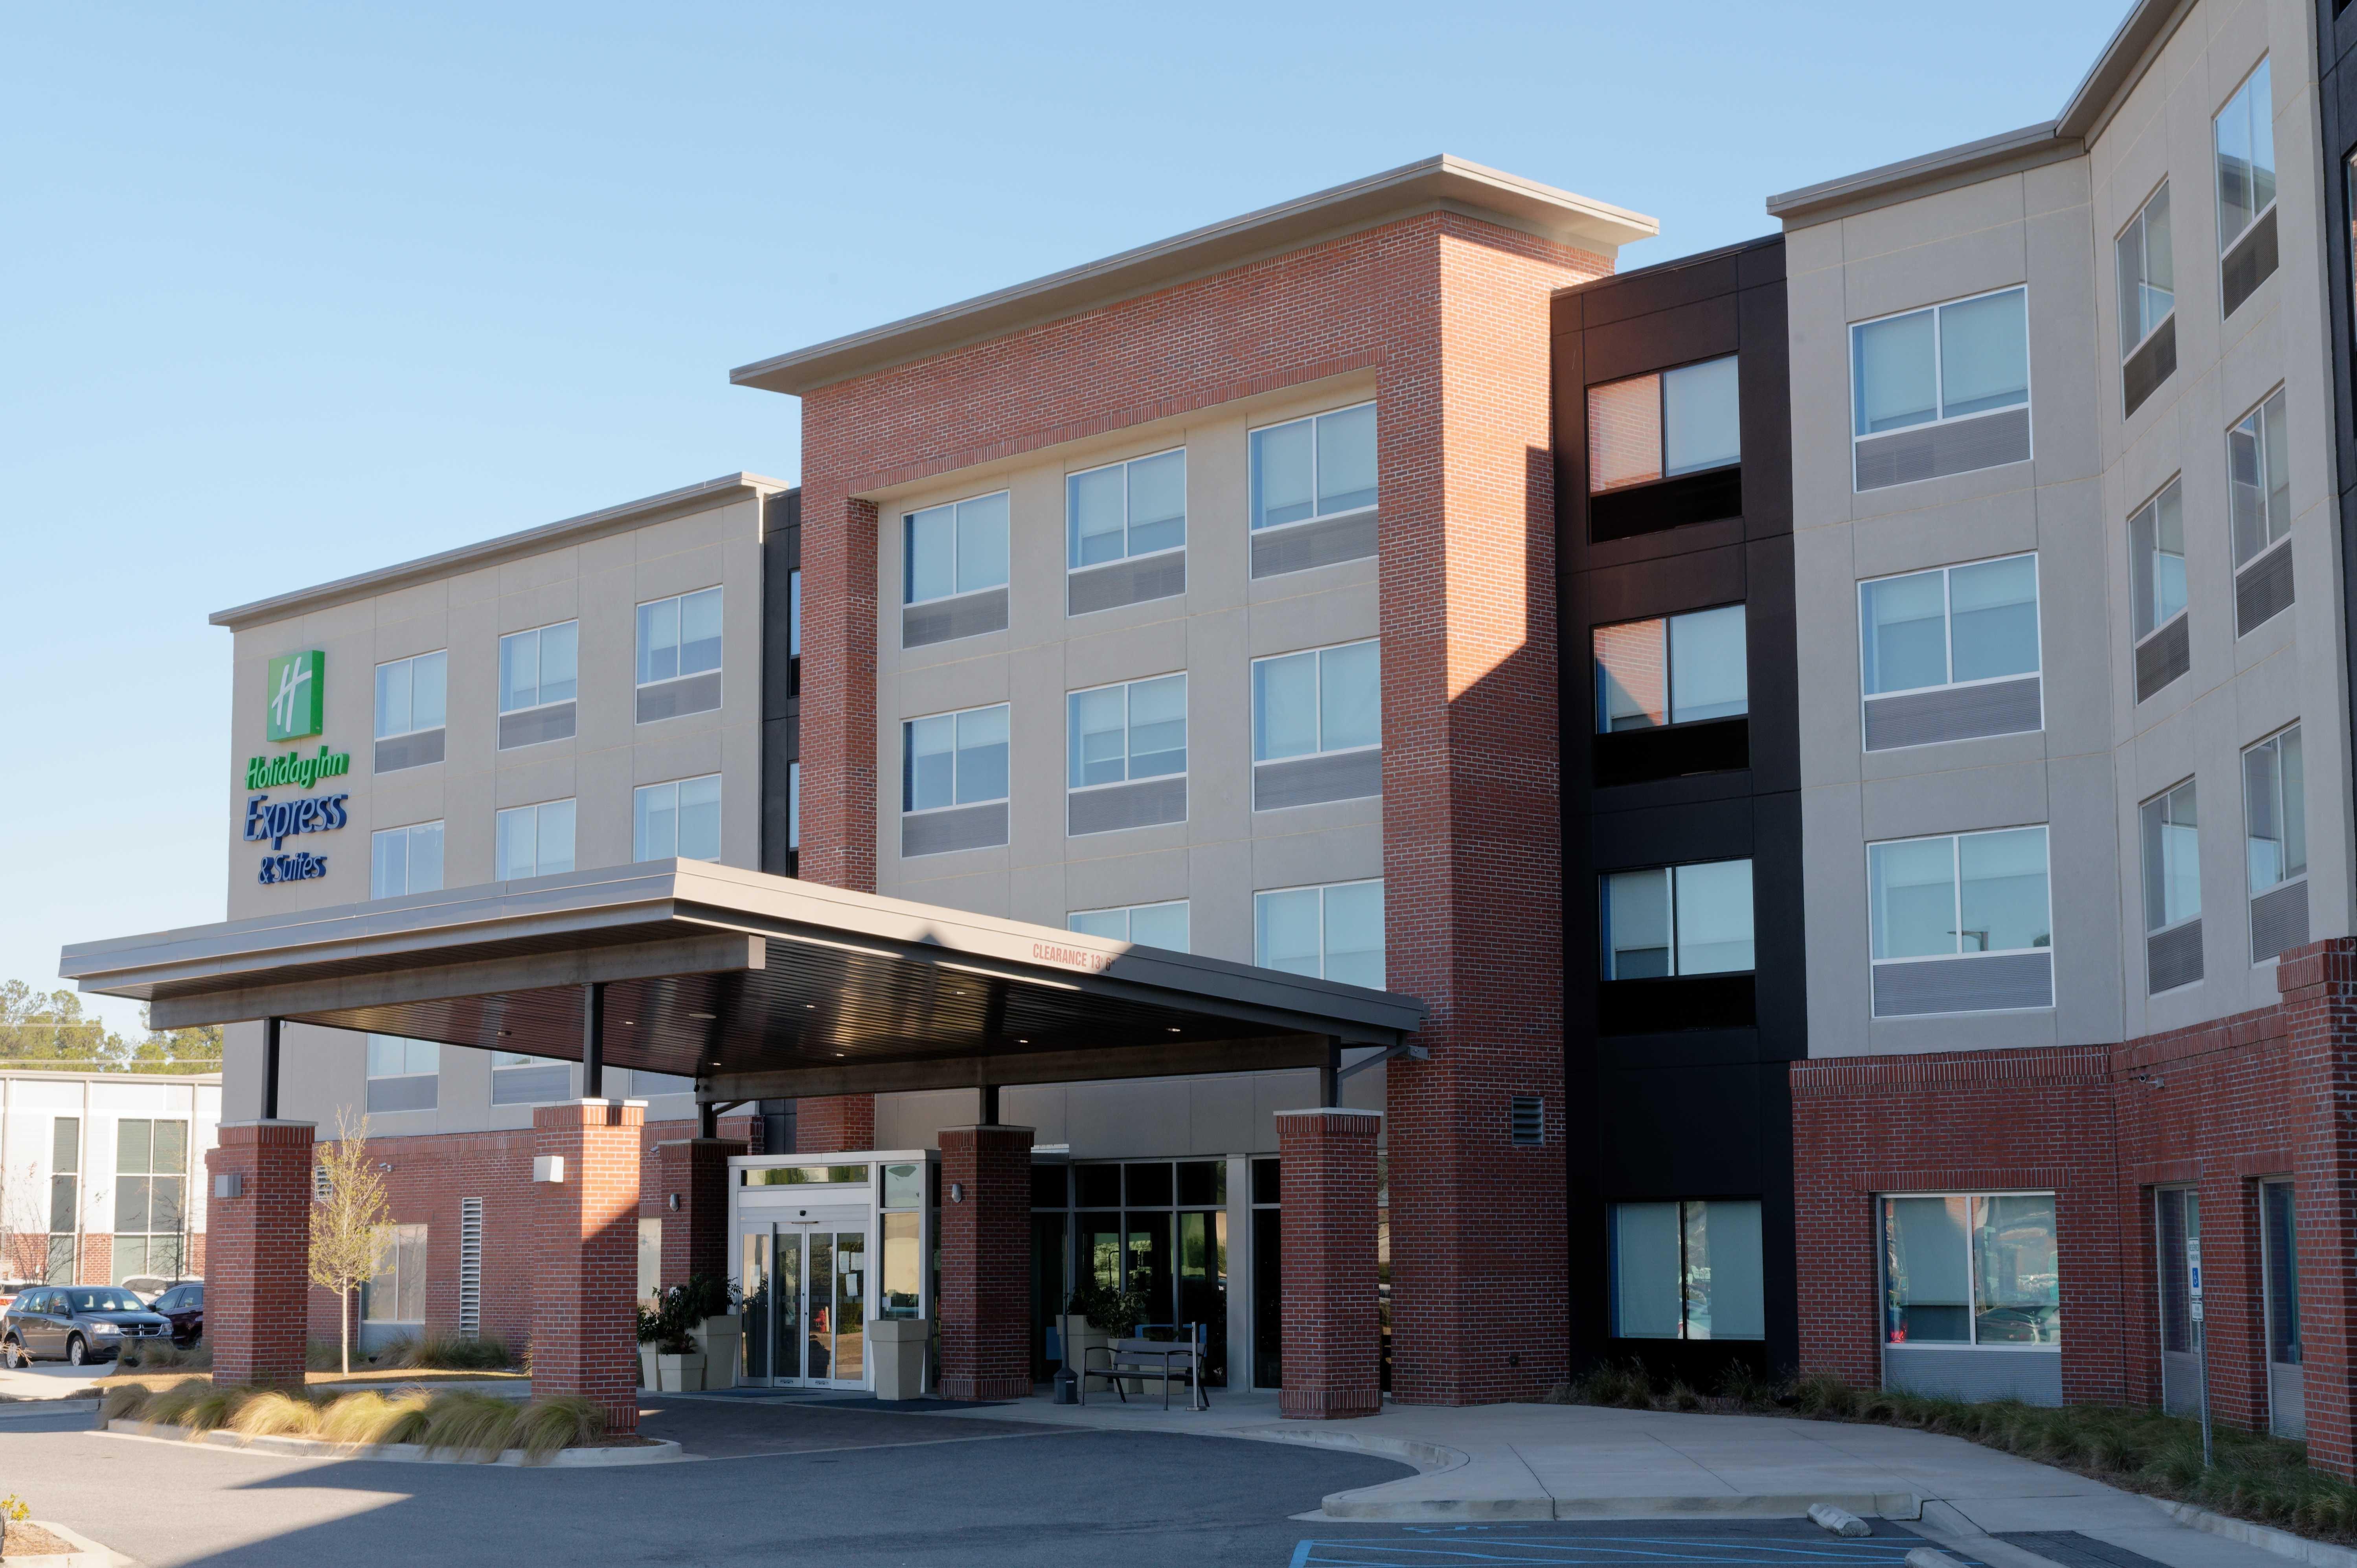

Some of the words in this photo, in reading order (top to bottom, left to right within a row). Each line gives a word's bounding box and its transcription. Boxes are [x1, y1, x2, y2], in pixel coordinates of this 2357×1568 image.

[245, 751, 317, 790] Holiday
[315, 745, 349, 778] Inn
[244, 794, 348, 850] Express
[258, 857, 275, 884] &
[272, 852, 327, 883] Suites
[1033, 944, 1087, 967] CLEARANCE
[1090, 954, 1103, 969] 13'
